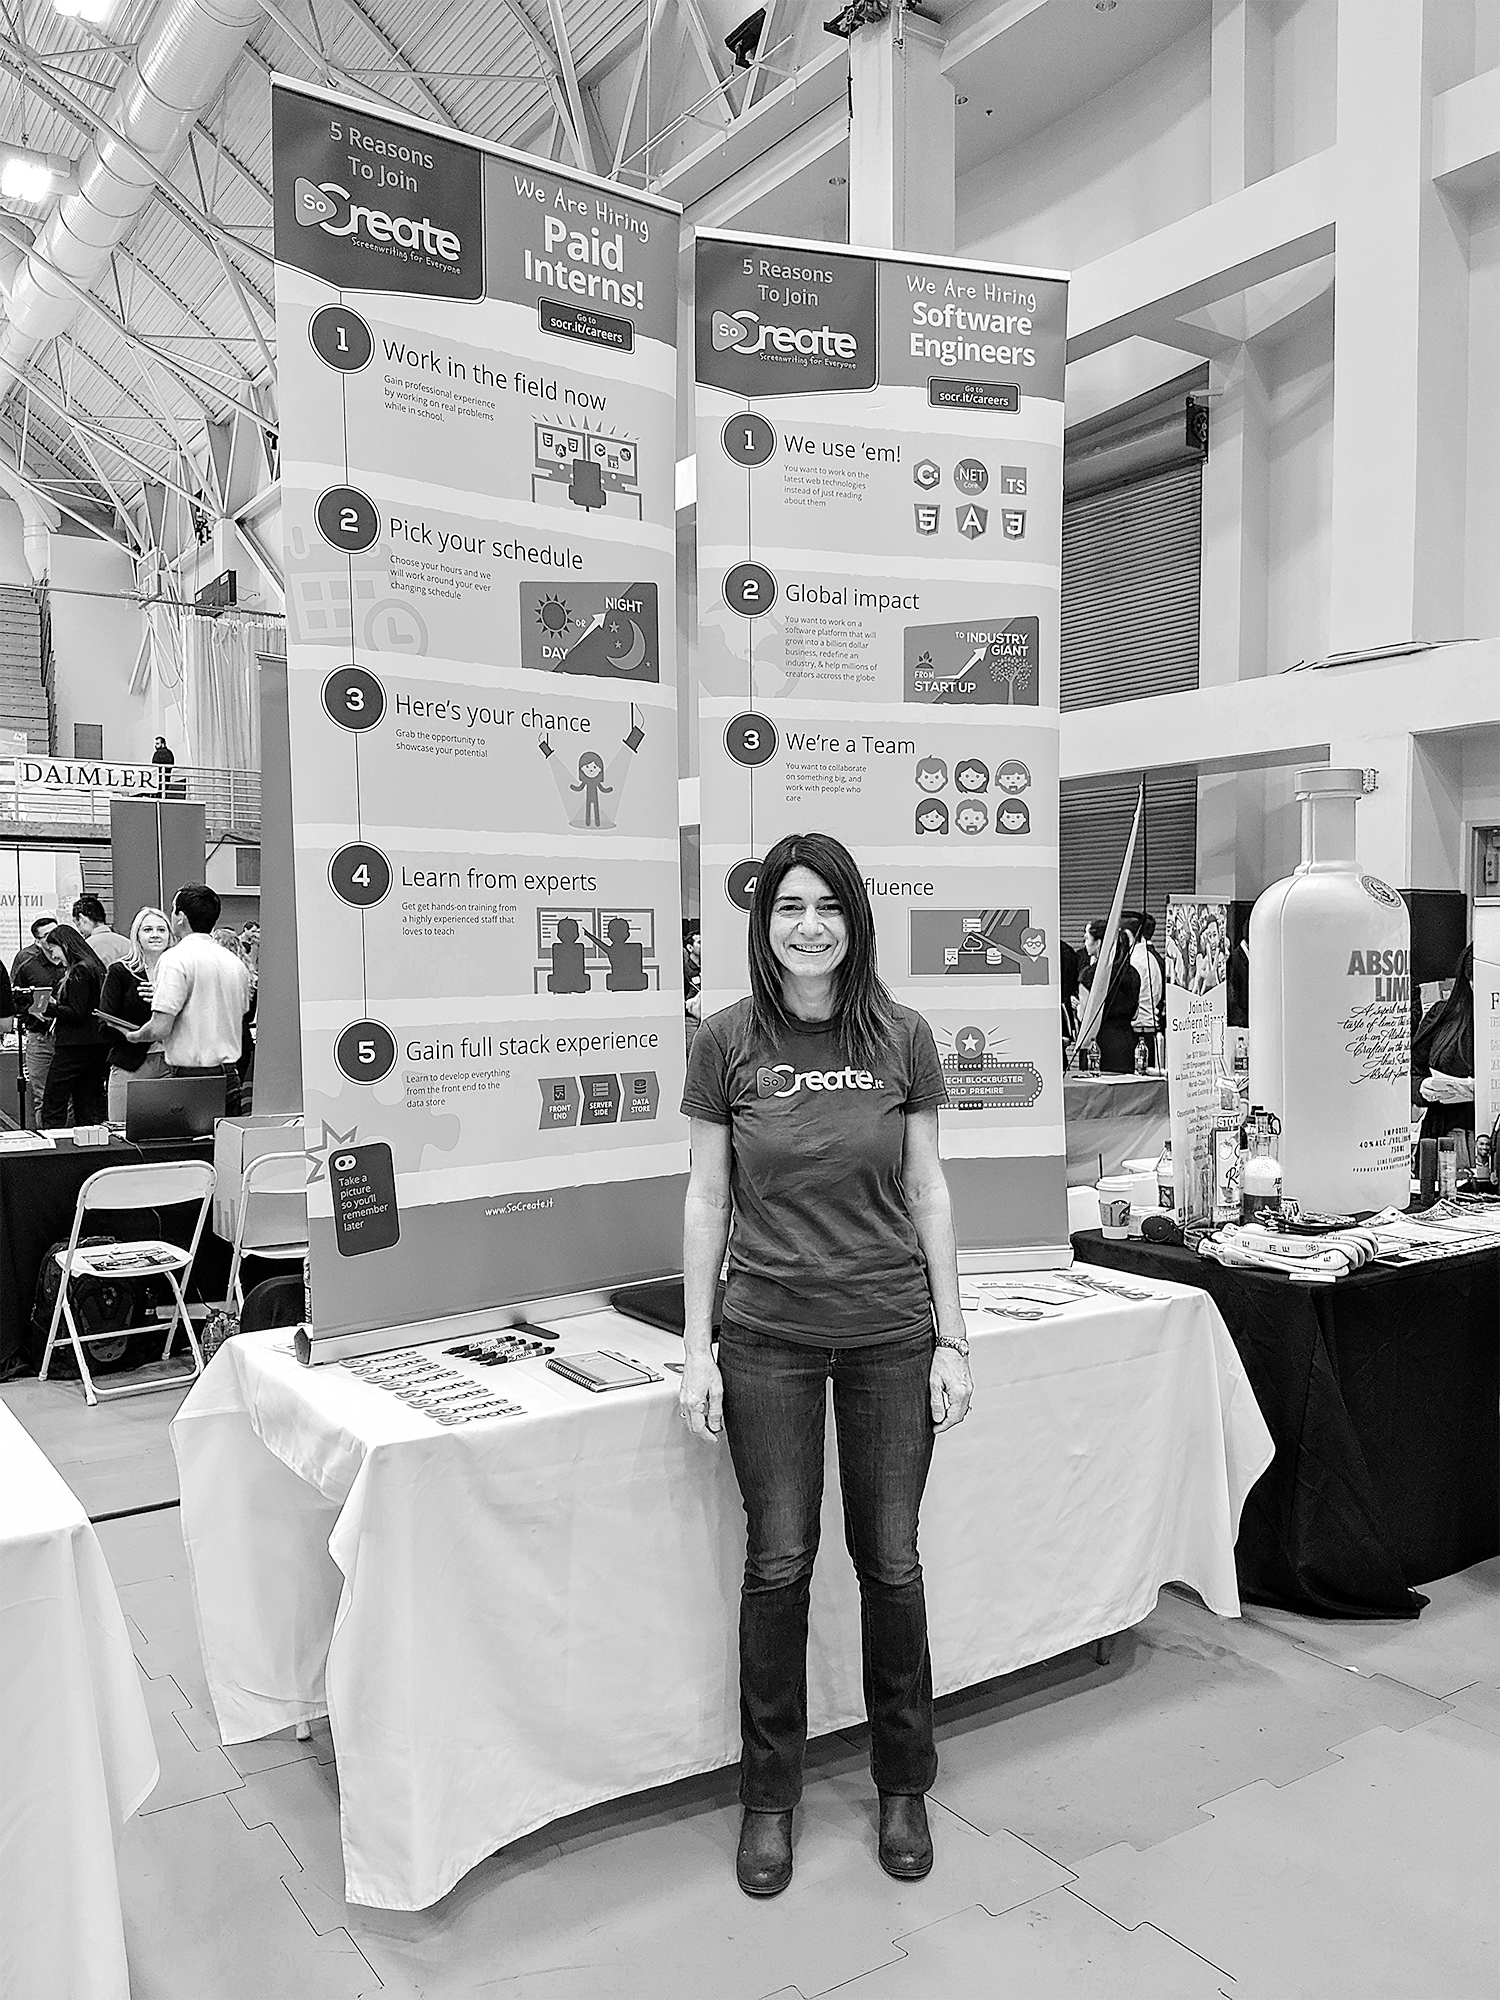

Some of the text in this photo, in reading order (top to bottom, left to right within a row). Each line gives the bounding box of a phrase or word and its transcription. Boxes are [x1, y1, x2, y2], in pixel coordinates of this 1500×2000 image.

[327, 121, 433, 169] 5 Reasons
[347, 155, 417, 192] To Join
[514, 175, 649, 243] We Are Hiring
[298, 182, 461, 260] SoCreate
[544, 215, 624, 272] Paid
[351, 236, 460, 274] Screenwriting for Everyone
[524, 250, 644, 310] Interns!
[742, 258, 833, 283] 5 Reasons
[757, 284, 818, 306] To Join
[906, 274, 1036, 313] We Are Hiring
[576, 313, 597, 326] Go to
[912, 302, 1032, 335] Software
[337, 327, 349, 352] 1
[550, 318, 623, 344] socr.it/careers
[714, 311, 857, 358] SoCreate
[910, 333, 1036, 367] Engineers
[759, 352, 856, 369] Screenwriting for Everyone
[382, 338, 606, 411] Work in the field now
[384, 374, 496, 409] Gain professional experience
[939, 392, 1008, 406] socr.it/careers
[743, 430, 754, 450] 1
[783, 464, 798, 472] You
[799, 466, 818, 474] want
[827, 469, 846, 477] work
[857, 471, 869, 479] the
[956, 469, 984, 482] .NET
[784, 474, 866, 490] latest web technologies
[1006, 478, 1024, 493] TS
[340, 508, 359, 532] 2
[961, 506, 983, 532] A
[390, 517, 582, 570] Pick your schedule
[389, 554, 491, 580] Choose your hours and we
[743, 580, 759, 599] 2
[785, 583, 920, 612] Global impact
[605, 597, 643, 613] NIGHT
[576, 618, 586, 627] OR
[966, 632, 1028, 644] INDUSTRY
[543, 646, 569, 660] DAY
[991, 646, 1028, 656] GIANT
[345, 687, 364, 711] 3
[466, 706, 515, 728] your
[521, 703, 591, 734] chance
[743, 730, 760, 749] 3
[845, 739, 856, 753] a
[861, 736, 915, 754] Team
[23, 762, 156, 789] DAIMLER
[785, 762, 800, 770] You
[828, 764, 867, 772] collaborate
[796, 774, 834, 783] something
[834, 774, 847, 784] big,
[848, 775, 862, 783] and
[351, 864, 370, 886] 4
[402, 866, 597, 895] Learn from experts
[865, 878, 934, 896] fluence
[401, 901, 517, 913] Get get hands-on training from
[1347, 950, 1409, 975] ABSOL
[1173, 1015, 1202, 1031] Southern
[358, 1041, 376, 1063] 5
[406, 1031, 658, 1061] Gain full stack experience
[550, 1104, 571, 1113] FRONT
[589, 1101, 613, 1109] SERVER
[631, 1105, 651, 1113] STORE
[632, 1098, 649, 1106] DATA
[553, 1112, 567, 1120] END
[594, 1108, 609, 1116] SIDE
[338, 1175, 360, 1187] Take
[340, 1184, 371, 1200] picture
[341, 1201, 352, 1209] so
[343, 1203, 388, 1220] remember
[485, 1198, 553, 1217] www.SoCreate.it
[344, 1220, 364, 1232] later
